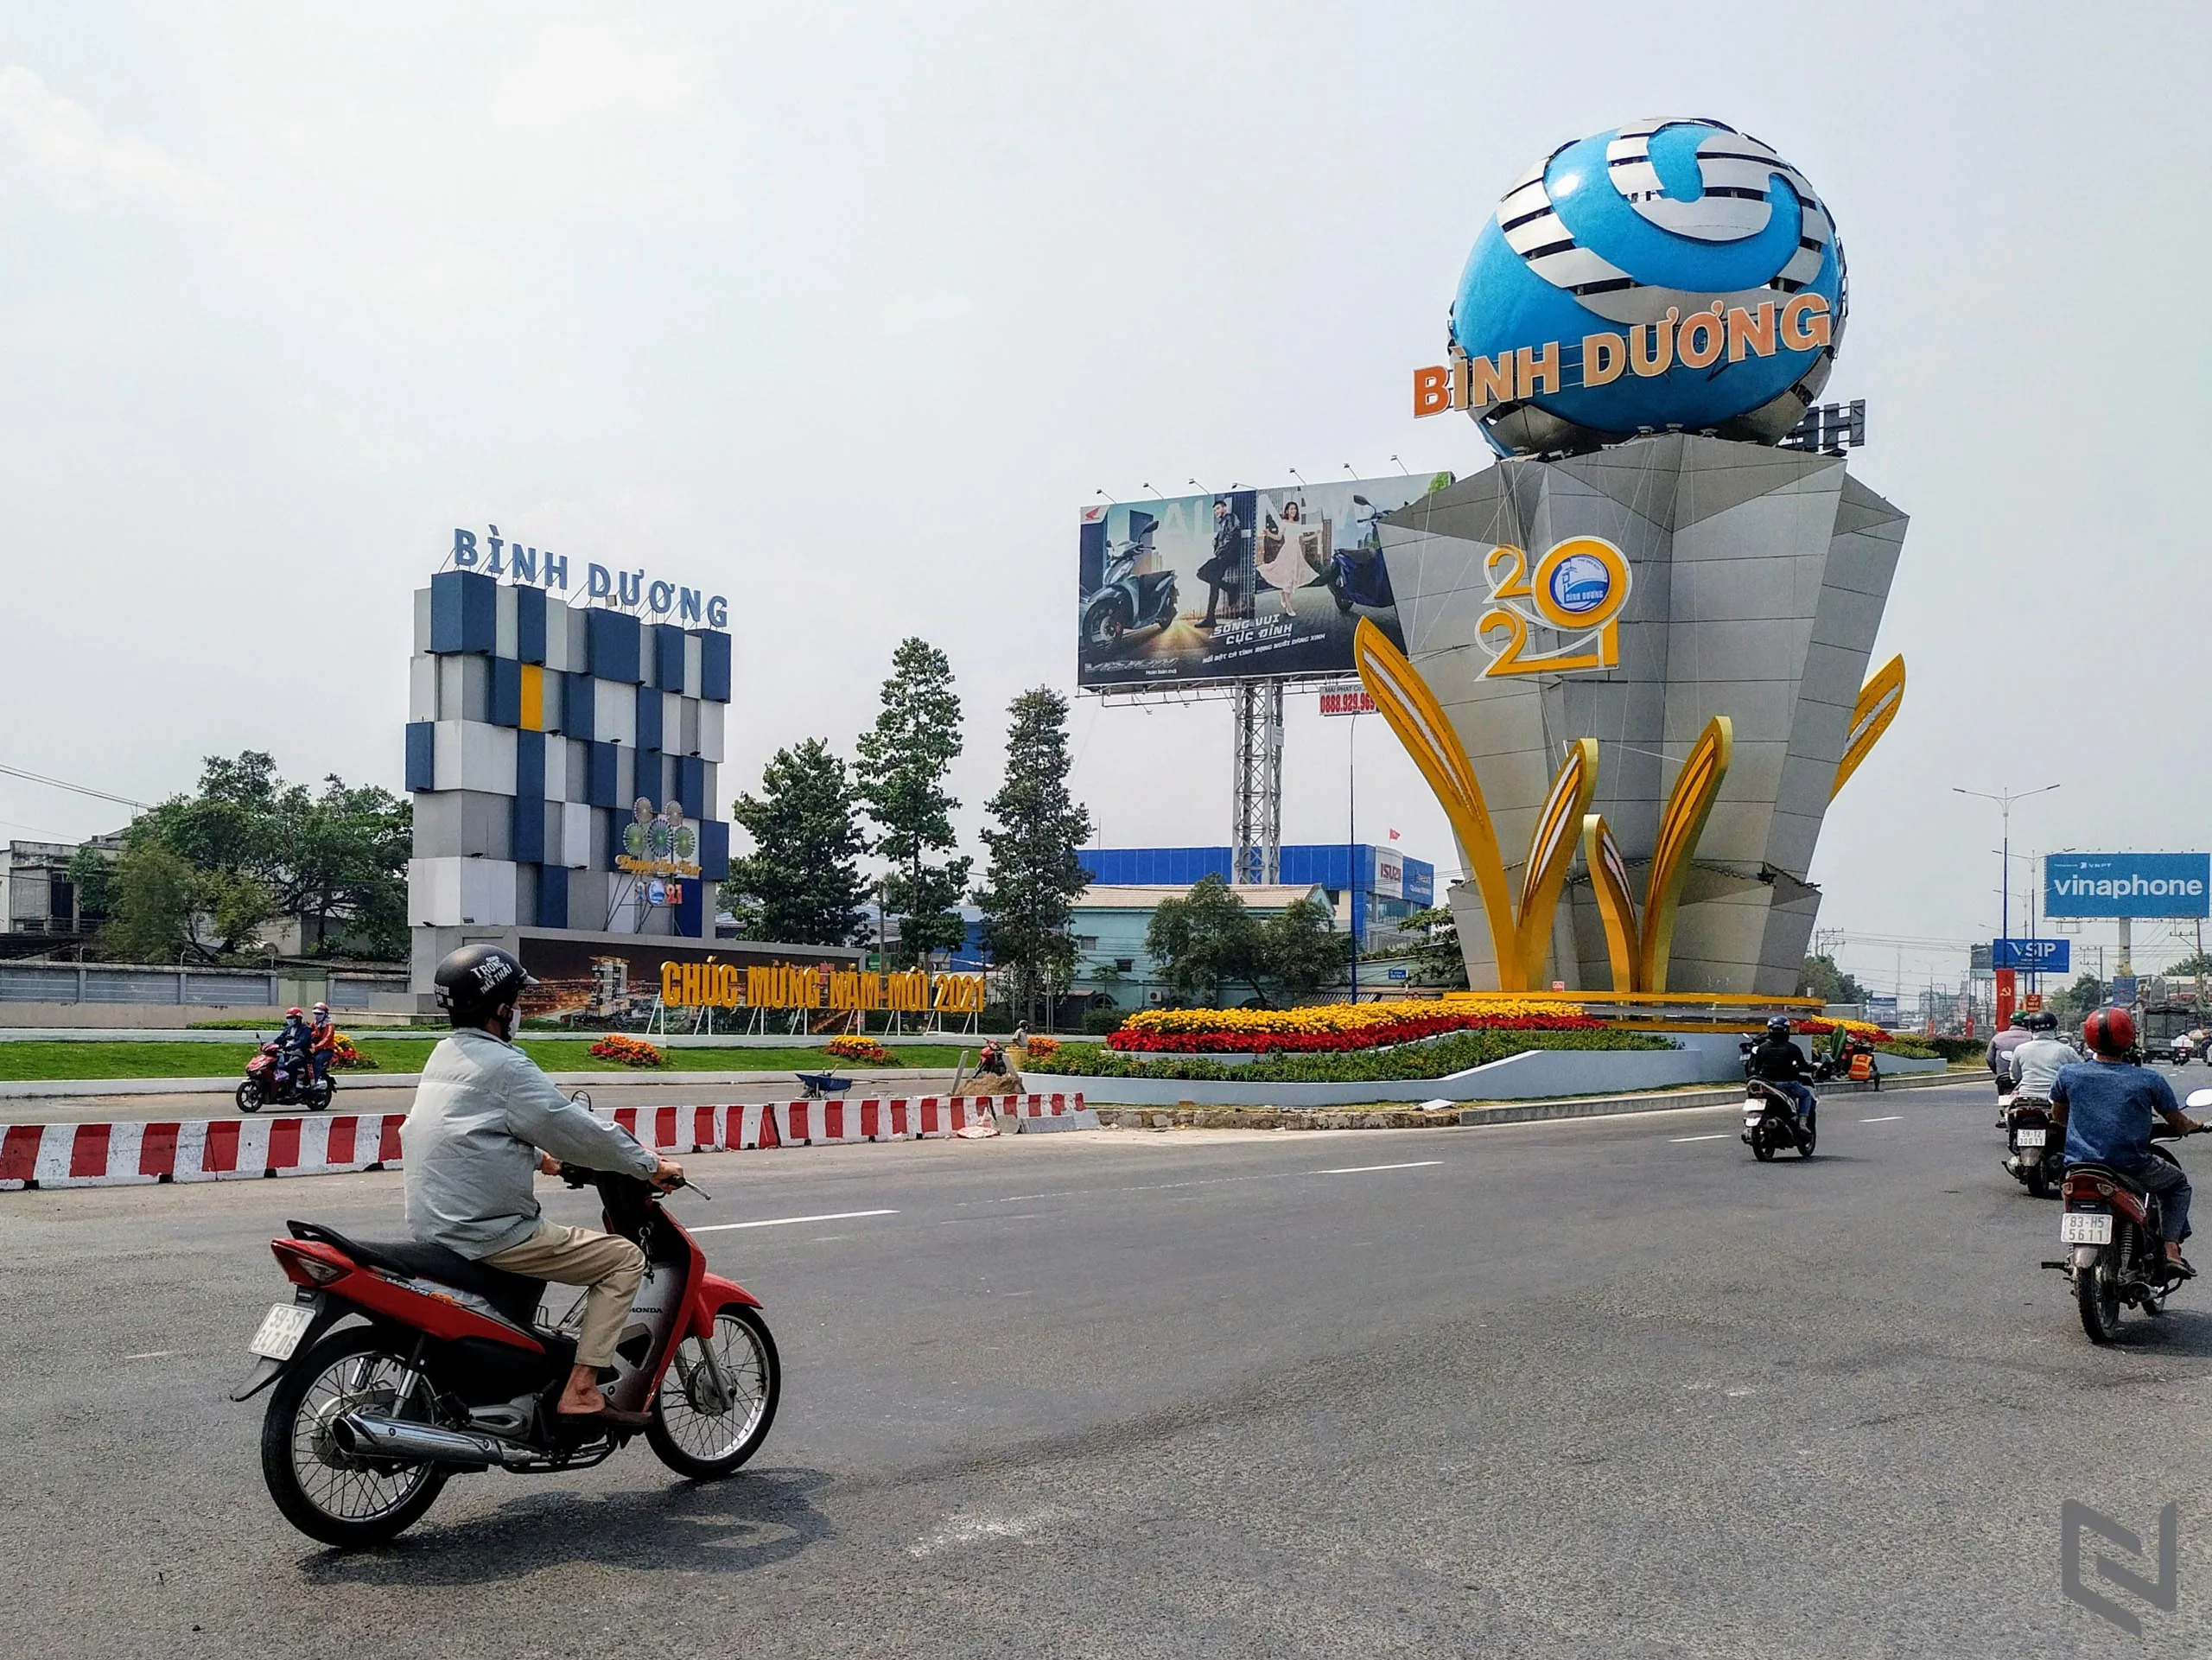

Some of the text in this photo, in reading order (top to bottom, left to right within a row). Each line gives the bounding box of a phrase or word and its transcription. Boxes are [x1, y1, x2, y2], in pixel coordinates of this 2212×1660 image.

[1413, 292, 1831, 418] BÌNH DƯƠNG
[454, 524, 728, 628] BÌNH DƯƠNG
[1255, 614, 1281, 626] VUI
[2054, 874, 2202, 899] vinaphone
[2006, 941, 2056, 957] VSIP
[661, 955, 985, 1013] CHÚC MỪNG NĂM MỚI 2021
[2069, 1216, 2104, 1228] 83-H5
[2069, 1228, 2102, 1242] 5611
